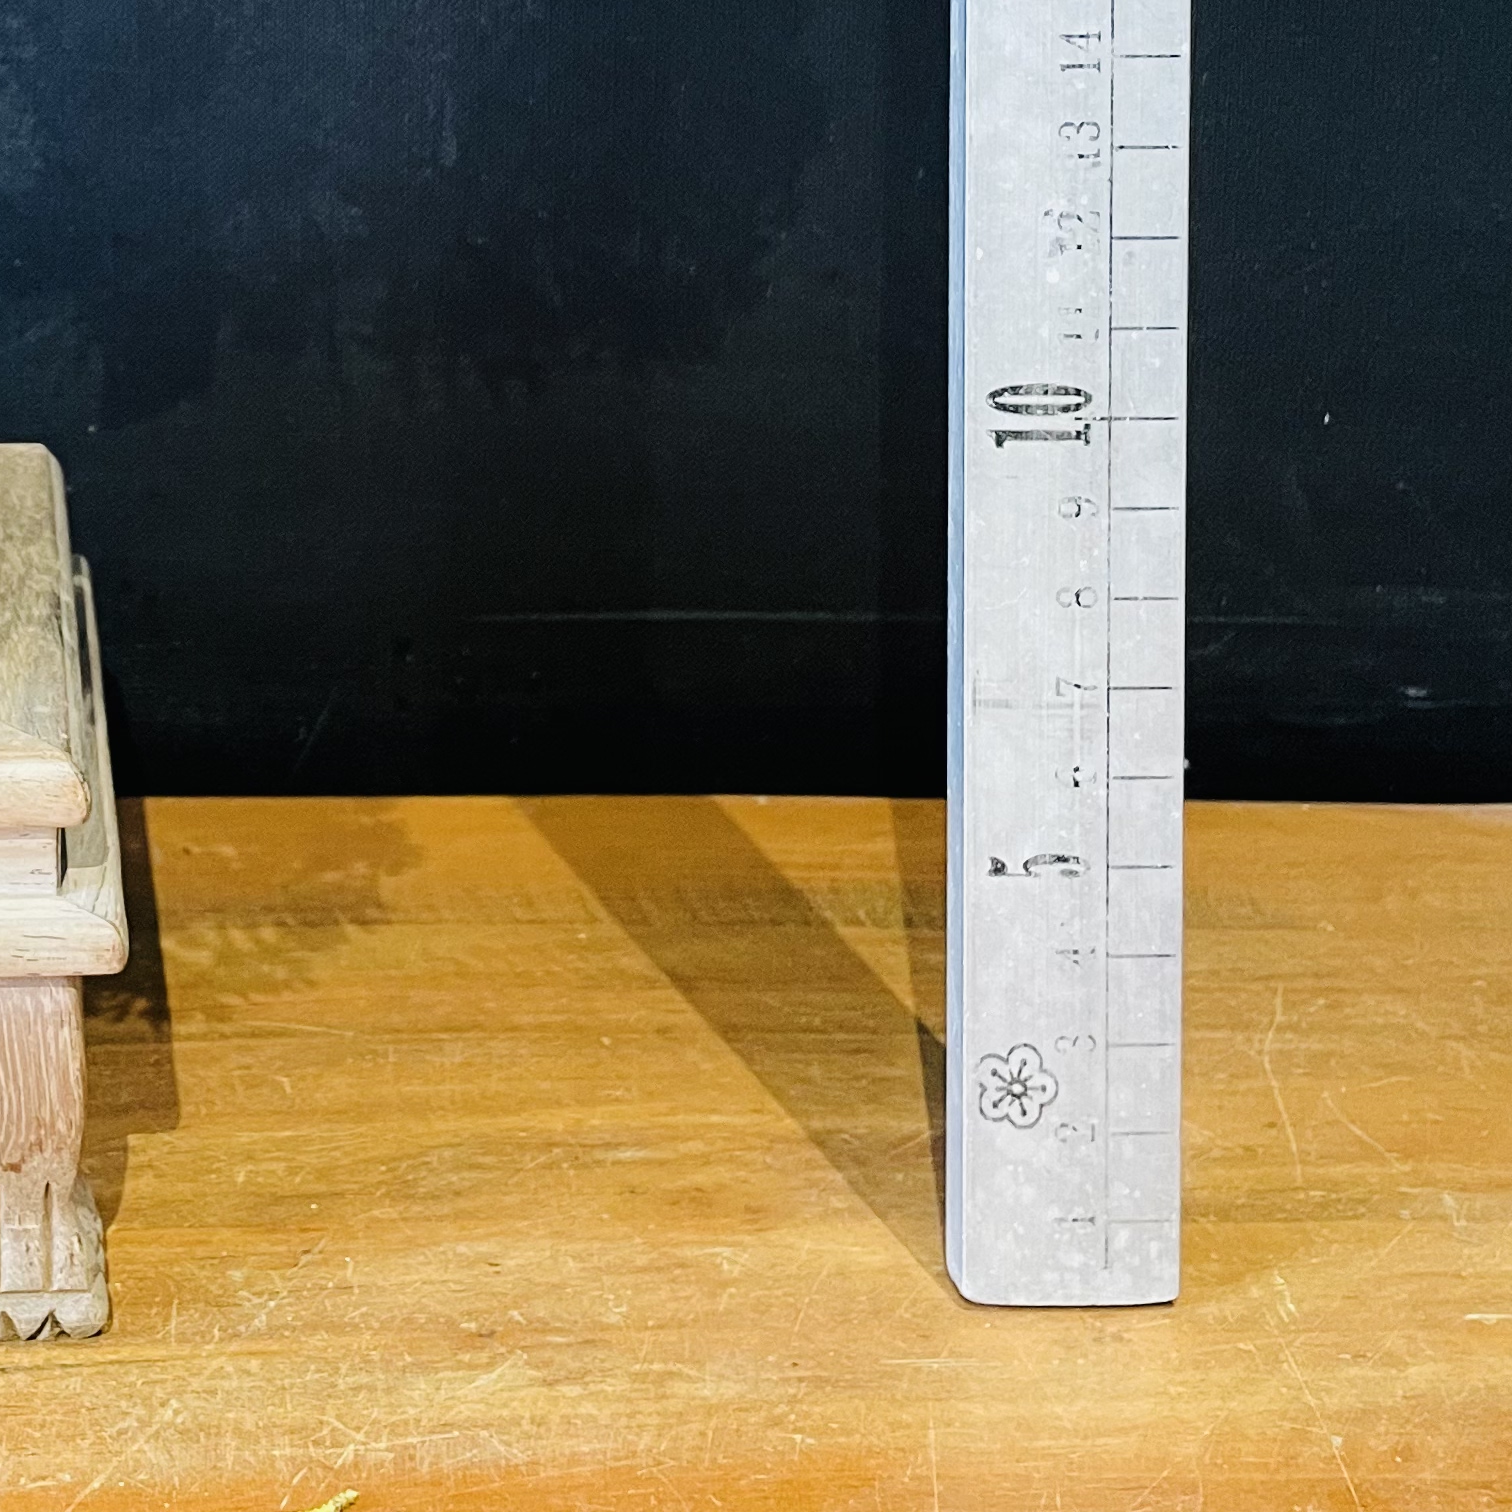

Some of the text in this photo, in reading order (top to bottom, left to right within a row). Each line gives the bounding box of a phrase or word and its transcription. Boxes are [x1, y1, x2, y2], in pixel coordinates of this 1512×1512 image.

[1059, 30, 1102, 73] 14
[1058, 121, 1101, 162] 13
[985, 382, 1093, 449] 10
[1058, 495, 1098, 518] 9
[1055, 586, 1098, 608] 8
[1055, 676, 1098, 697] 7
[987, 853, 1091, 877] 5
